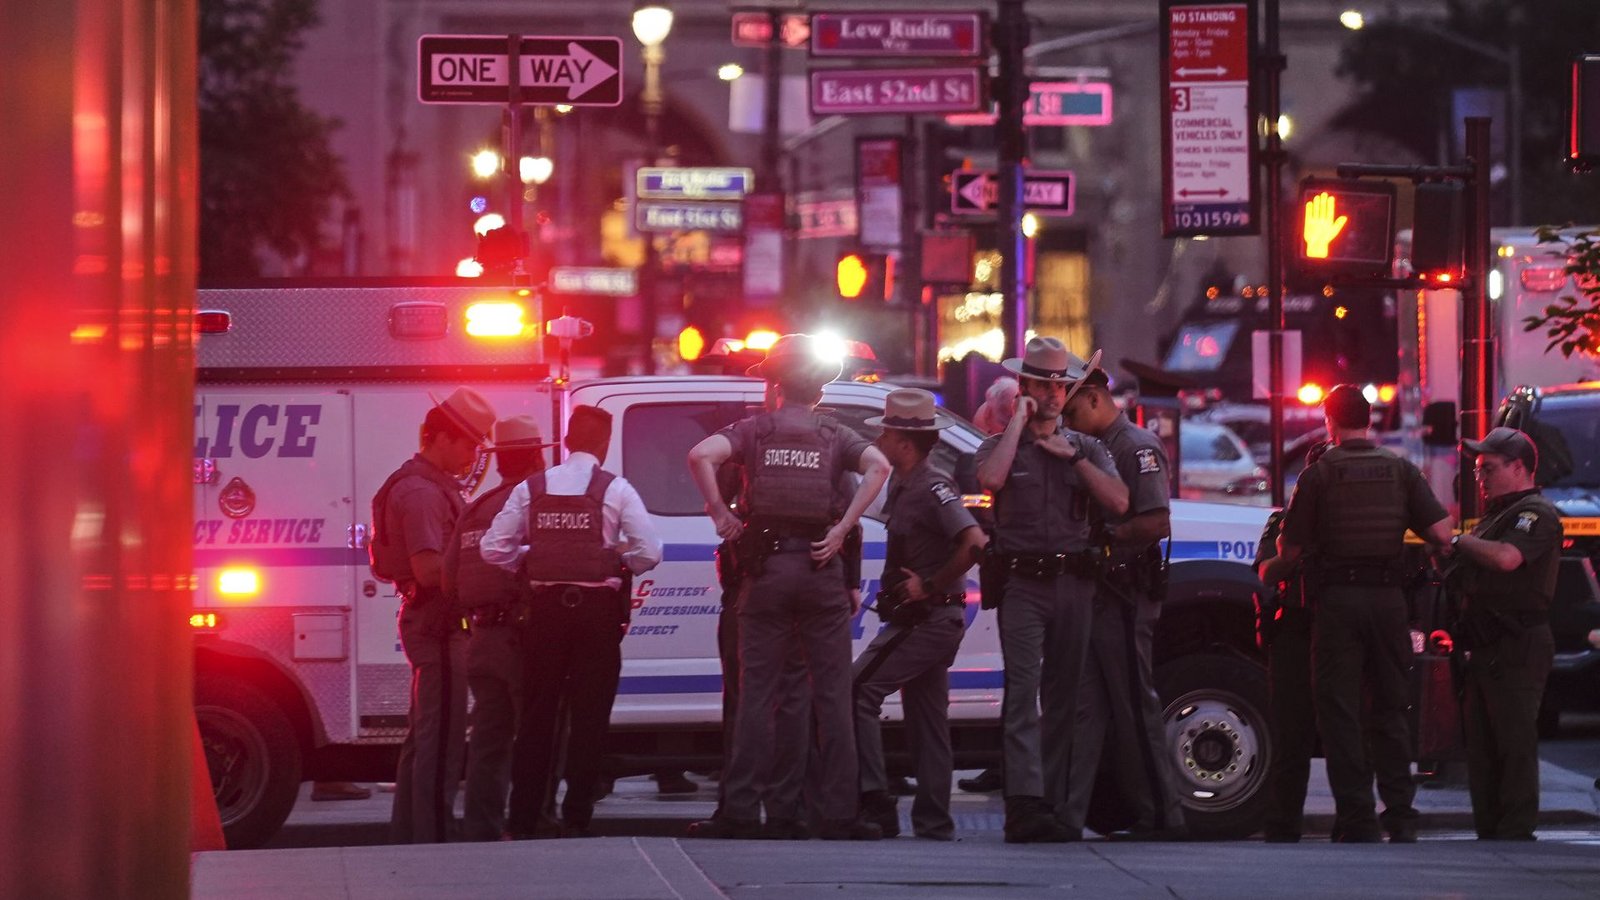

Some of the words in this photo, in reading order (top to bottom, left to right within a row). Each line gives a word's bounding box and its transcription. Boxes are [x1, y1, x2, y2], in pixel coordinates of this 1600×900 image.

[1172, 11, 1186, 23] NO
[1188, 11, 1236, 23] STANDING
[840, 18, 883, 39] Lew
[888, 17, 951, 39] Rudin
[438, 57, 496, 82] ONE
[531, 59, 593, 83] WAY
[821, 80, 874, 104] East
[879, 79, 940, 104] 52nd
[943, 79, 971, 103] St
[1174, 89, 1188, 111] 3
[1174, 117, 1233, 128] COMMERCIAL
[1175, 130, 1217, 141] VEHICLES
[1220, 130, 1243, 140] ONLY
[1174, 211, 1232, 228] 103159
[764, 448, 789, 466] STATE
[790, 450, 820, 469] POLICE
[537, 512, 560, 529] STATE
[561, 512, 590, 529] POLICE
[227, 518, 325, 544] SERVICE
[636, 580, 710, 597] COURTESY
[626, 624, 680, 636] ESPECT
